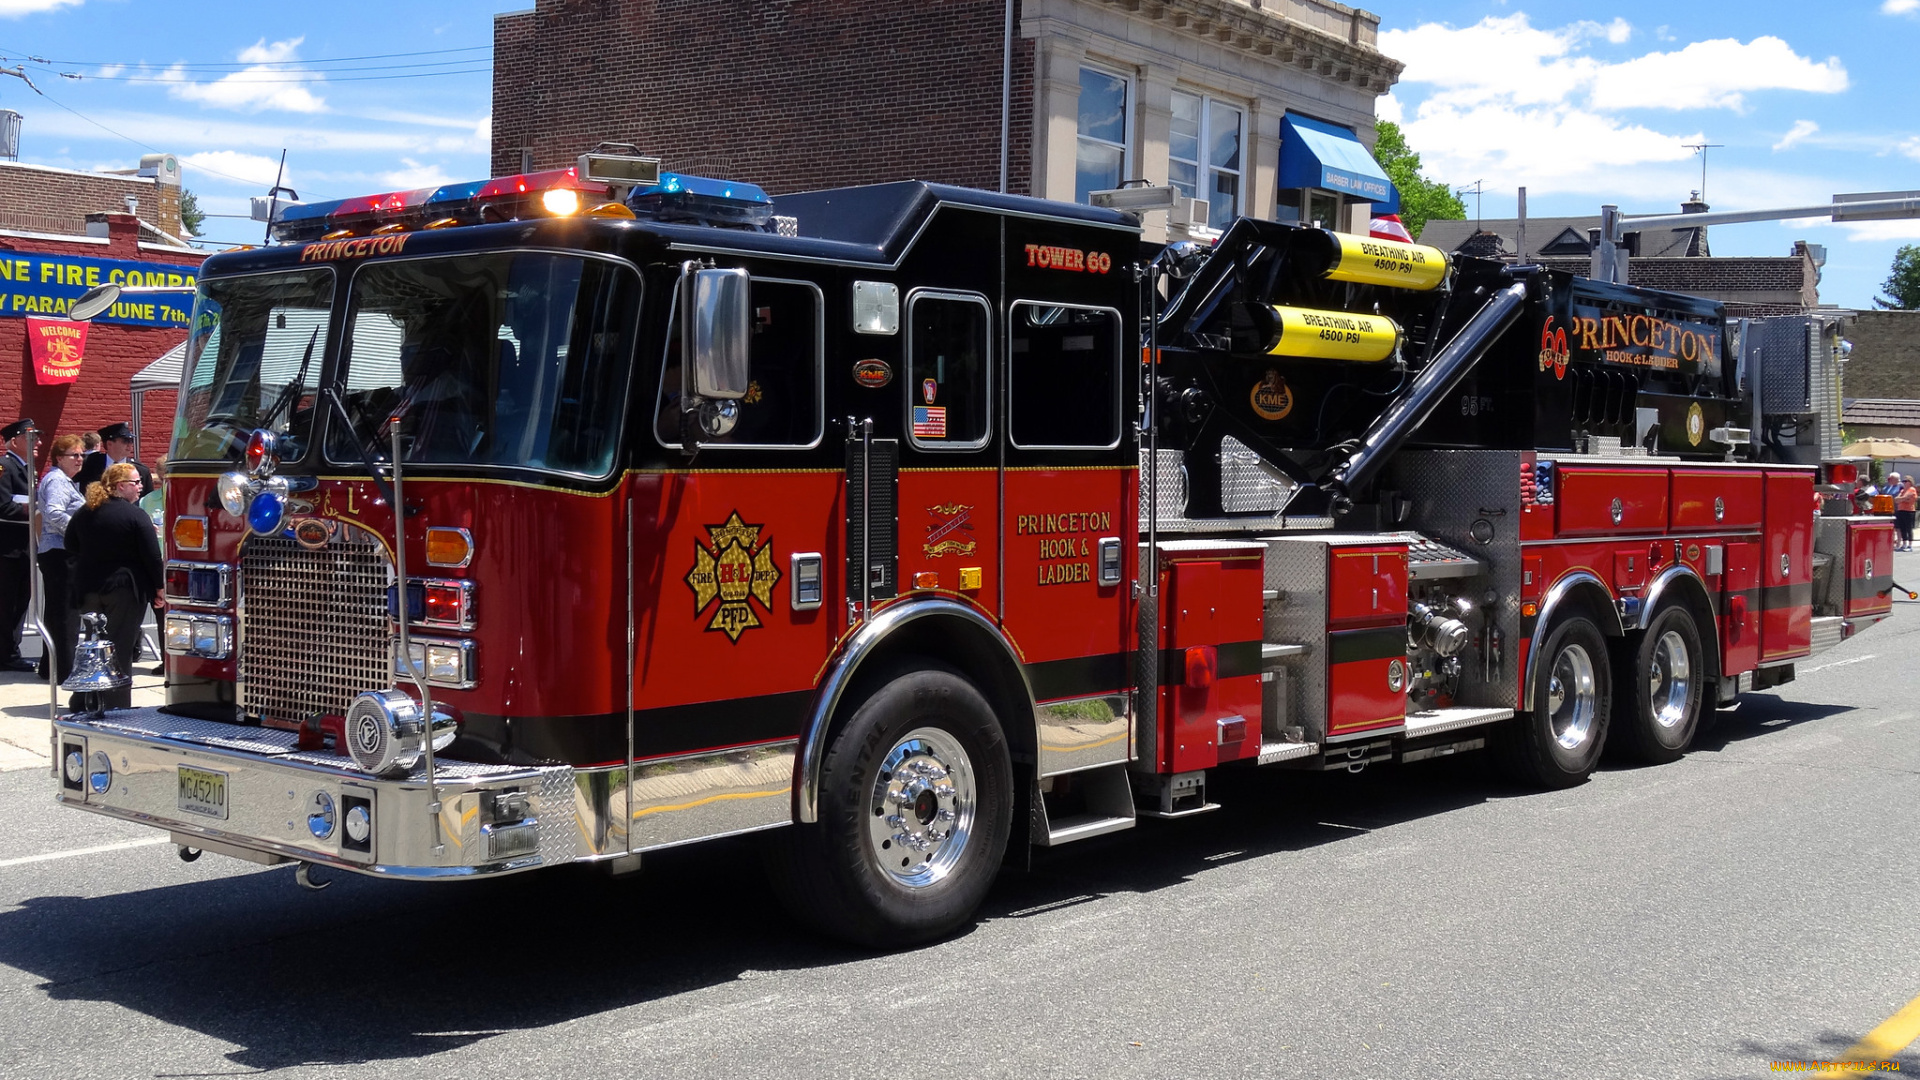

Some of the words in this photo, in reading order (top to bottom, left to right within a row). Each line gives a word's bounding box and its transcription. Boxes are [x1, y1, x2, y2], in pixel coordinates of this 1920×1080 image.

[1326, 173, 1349, 187] BARBER
[1350, 179, 1362, 189] LAW
[1364, 182, 1386, 196] OFFICES
[300, 234, 411, 262] PRINCETON
[1361, 243, 1409, 261] BREATHING
[1412, 251, 1426, 264] AIR
[1024, 244, 1085, 272] TOWER
[1086, 251, 1111, 274] 60
[1374, 258, 1397, 271] 4500
[1399, 262, 1413, 274] PSI
[40, 263, 100, 287] FIRE
[108, 303, 155, 320] JUNE
[160, 306, 190, 324] 7th,
[1303, 313, 1355, 331] BREATHING
[1359, 321, 1374, 333] AIR
[40, 326, 81, 339] WELCOME
[1319, 329, 1343, 341] 4500
[1346, 332, 1360, 344] PSI
[1541, 315, 1567, 380] 60
[1606, 350, 1634, 364] HOOK
[1634, 353, 1641, 365] &
[1642, 354, 1679, 369] LADDER
[1259, 393, 1286, 405] KME
[1461, 395, 1478, 416] 95
[1017, 512, 1110, 535] PRINCETON
[1040, 538, 1076, 560] HOOK
[1081, 538, 1090, 556] &
[692, 572, 713, 584] FIRE
[1038, 562, 1091, 585] LADDER
[721, 606, 749, 631] PFD
[179, 776, 224, 806] MG45210
